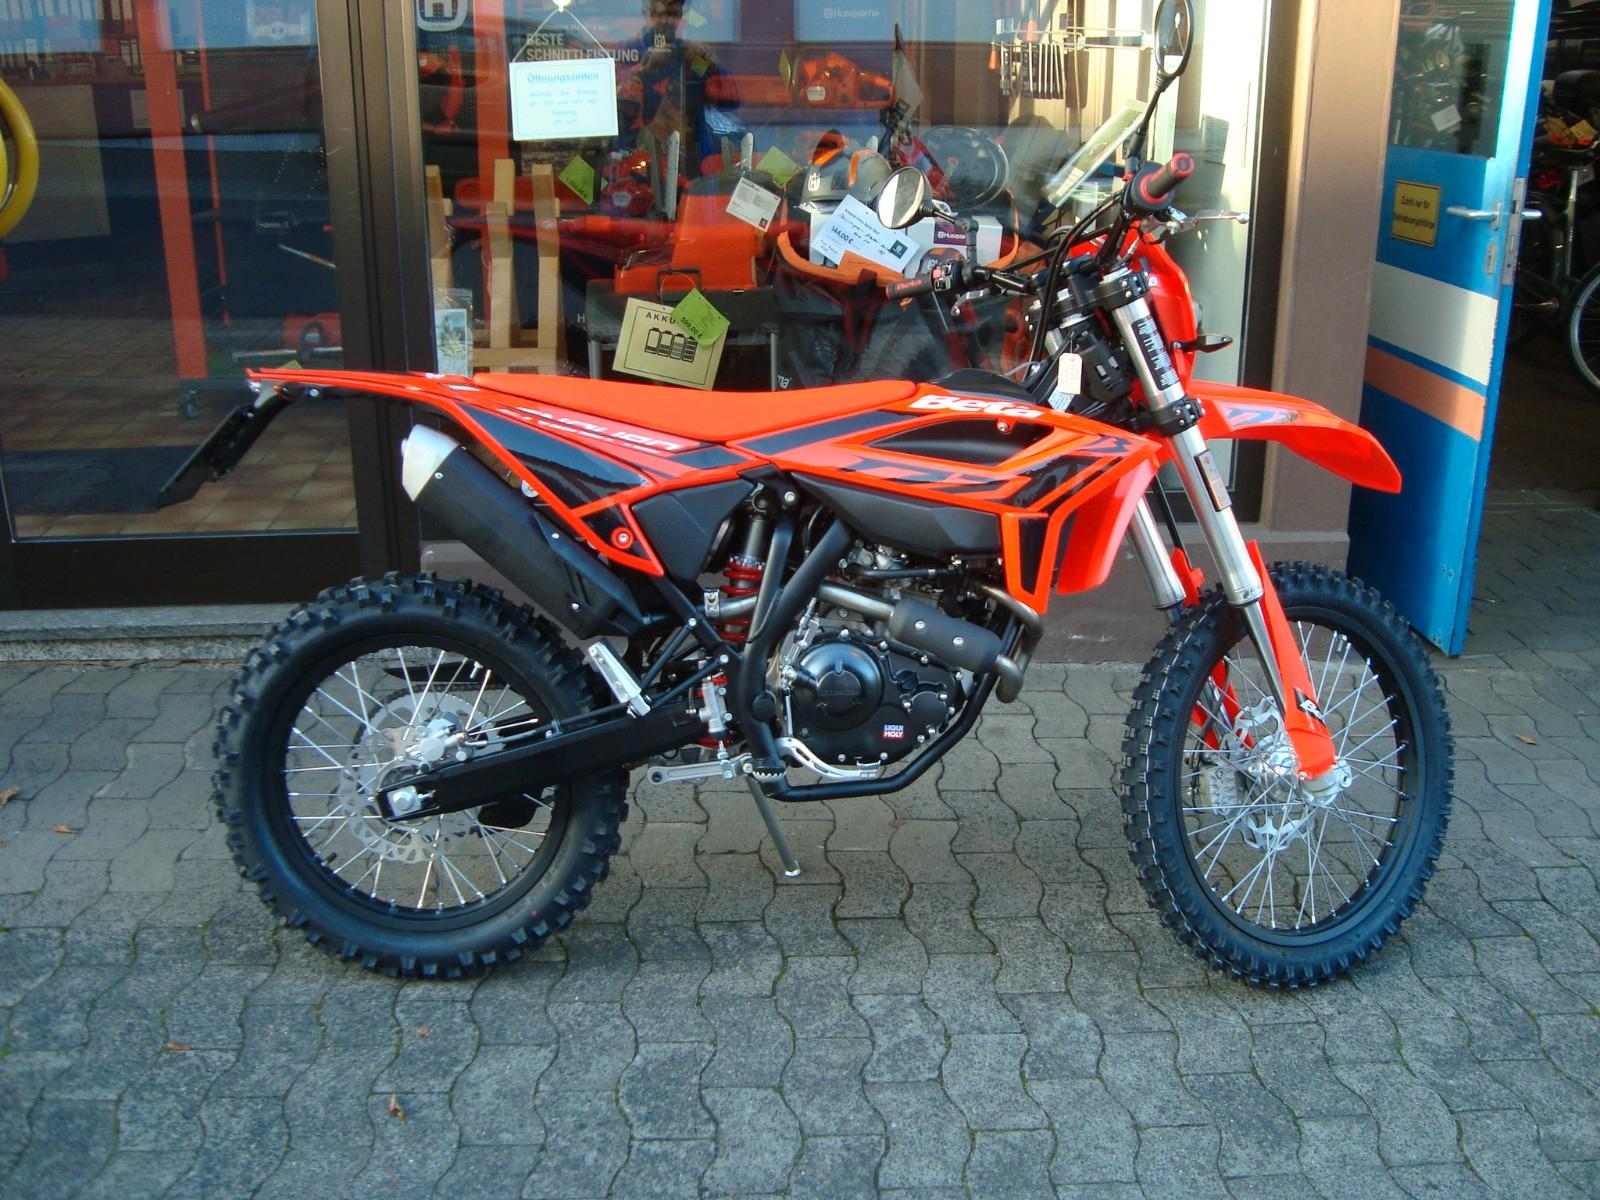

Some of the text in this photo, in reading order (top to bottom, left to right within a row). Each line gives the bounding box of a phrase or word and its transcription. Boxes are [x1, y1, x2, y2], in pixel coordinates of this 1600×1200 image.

[833, 8, 880, 19] Husqvarna
[526, 33, 565, 46] BESTE
[526, 49, 640, 62] SCHNITTLEISTUNG
[907, 394, 1045, 418] Beta
